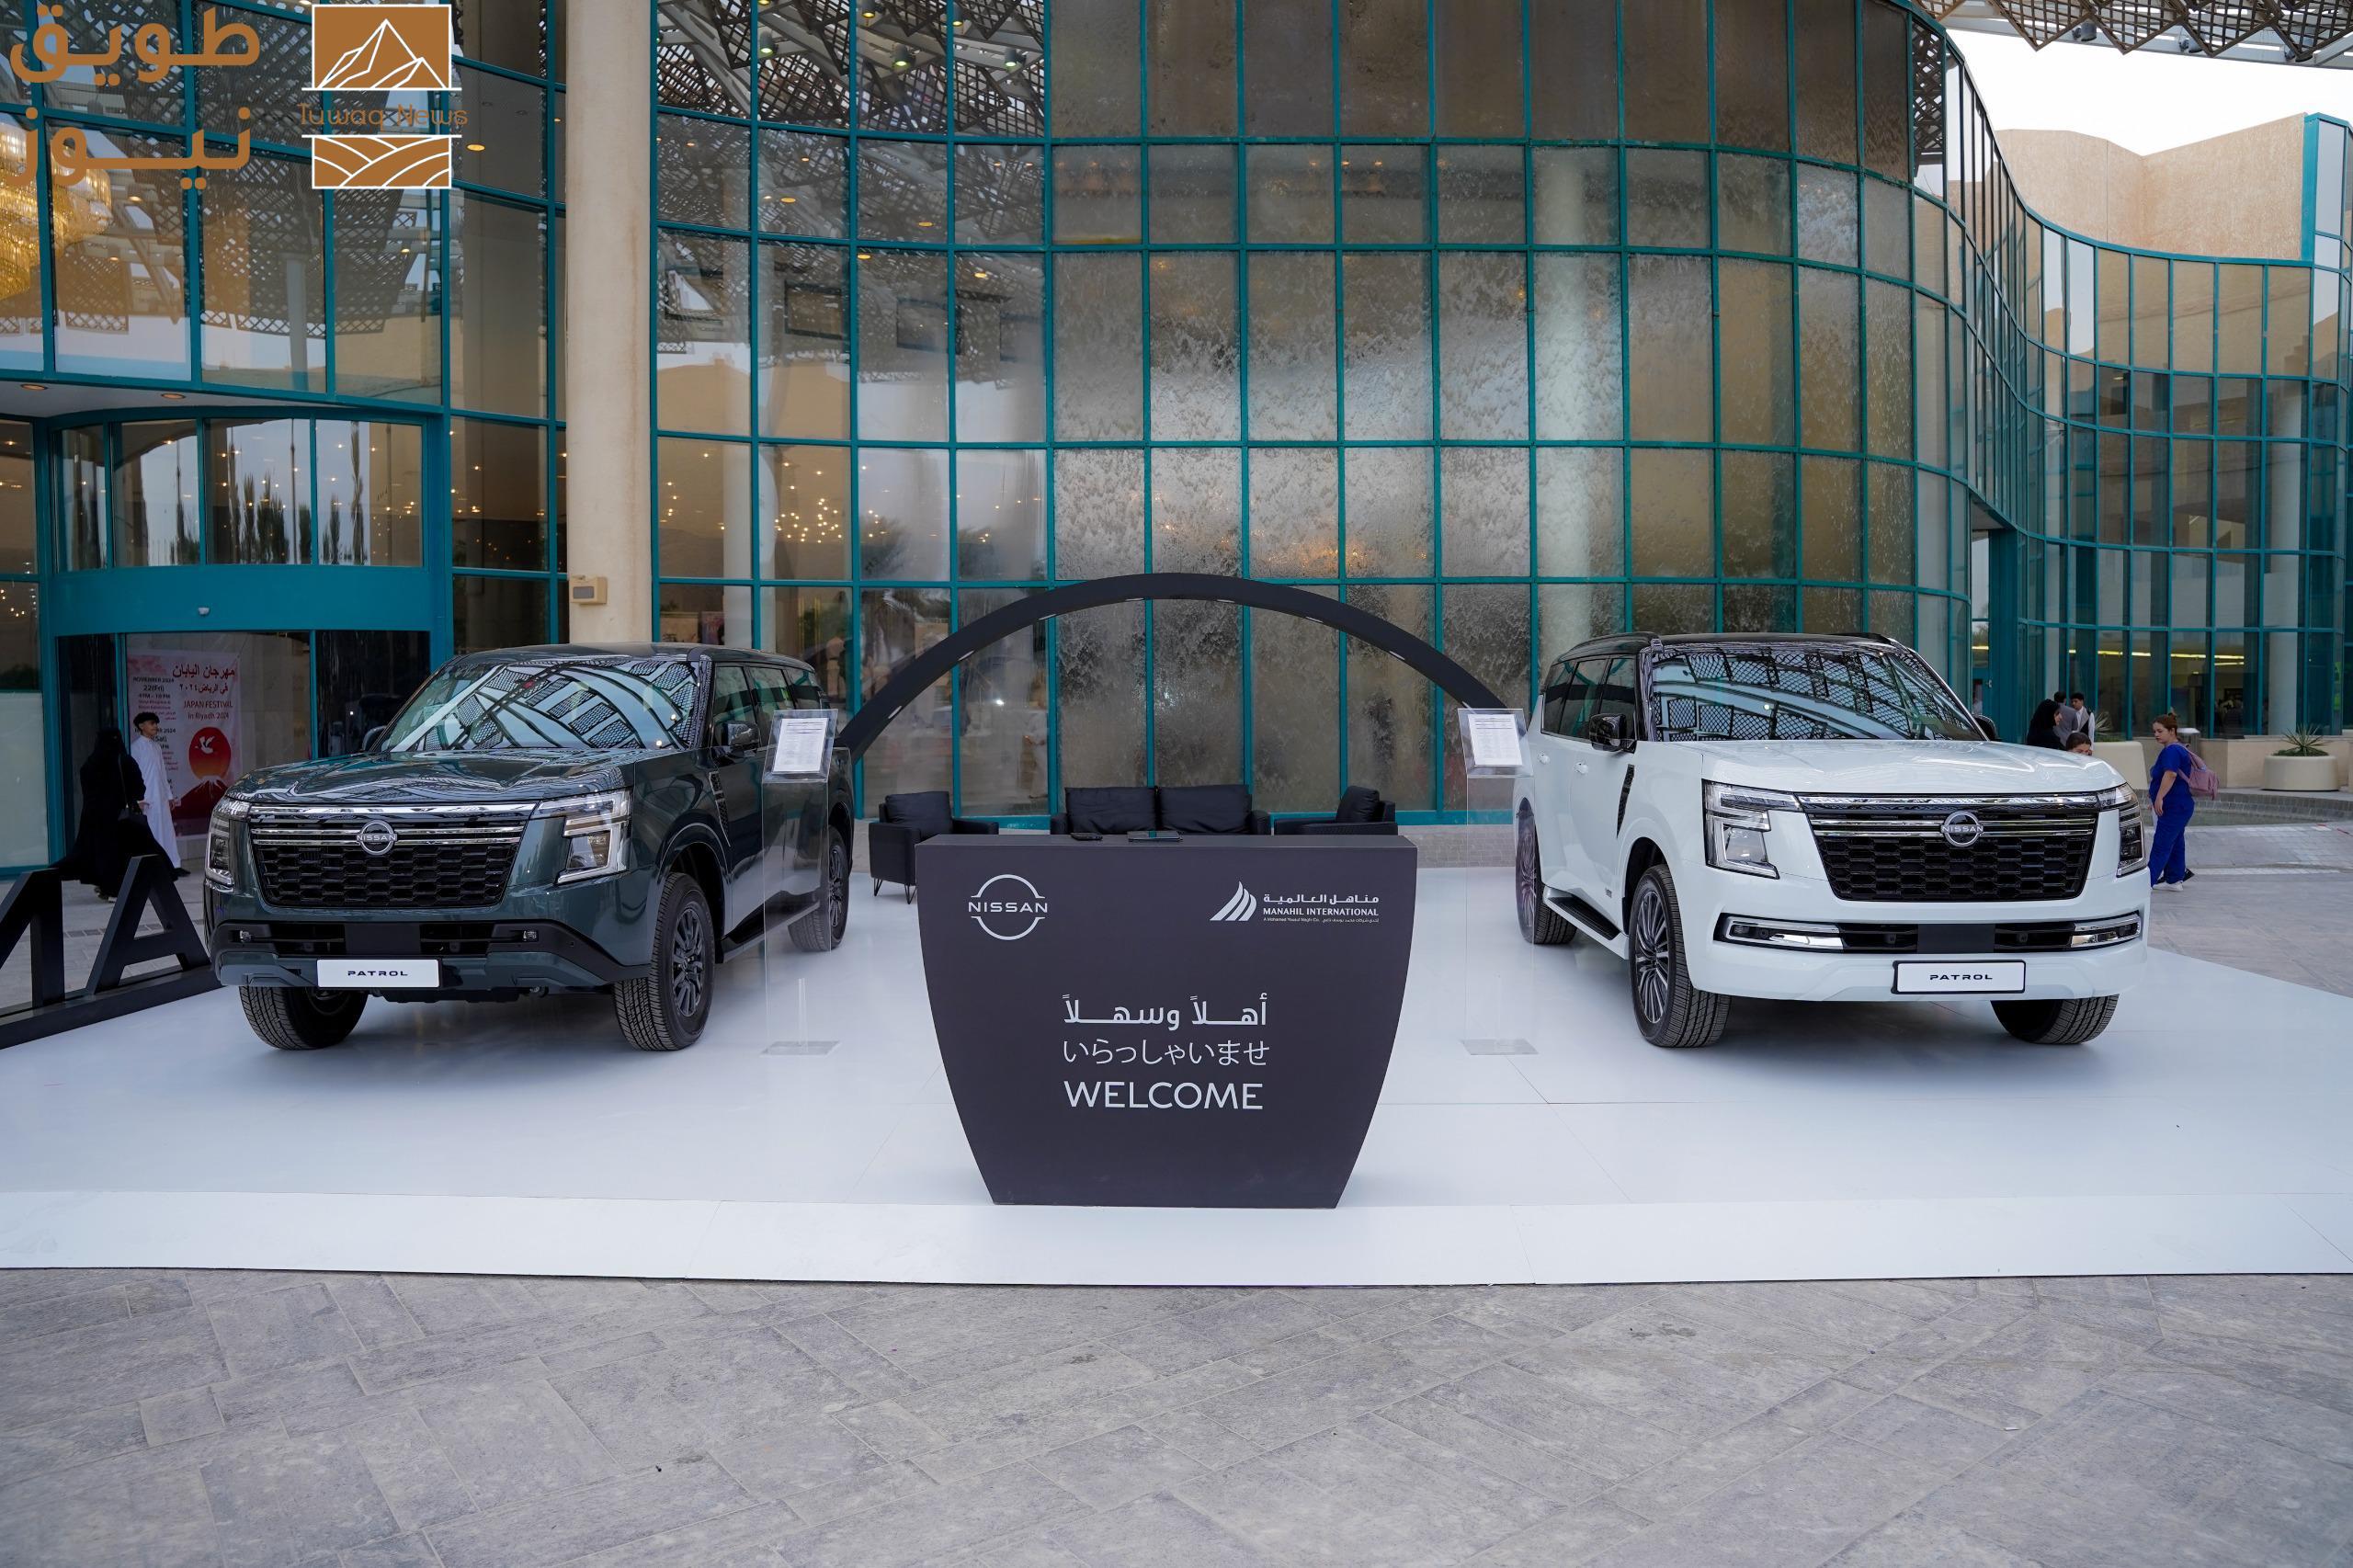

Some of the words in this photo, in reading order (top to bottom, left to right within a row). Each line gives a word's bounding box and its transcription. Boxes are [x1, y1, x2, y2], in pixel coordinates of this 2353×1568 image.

[173, 663, 199, 677] اليابان
[203, 665, 234, 679] مهرجان
[221, 683, 228, 694] في
[184, 699, 204, 709] JAPAN
[205, 699, 233, 709] FESTIVAL
[188, 711, 195, 720] in
[195, 711, 215, 722] Riyadh
[216, 711, 229, 721] 2024
[1941, 825, 1984, 834] NISSAN
[357, 834, 397, 842] NISSAN
[1263, 893, 1327, 905] العالمية
[1329, 894, 1380, 905] مناهل
[968, 902, 1048, 914] NISSAN
[1263, 907, 1305, 915] MANAHIL
[1306, 907, 1380, 916] INTERNATIONAL
[1062, 994, 1180, 1031] وسهلاً
[1189, 992, 1267, 1026] أهلاً
[1063, 1038, 1270, 1066] いらっしゃいませ
[1063, 1080, 1263, 1110] WELCOME
